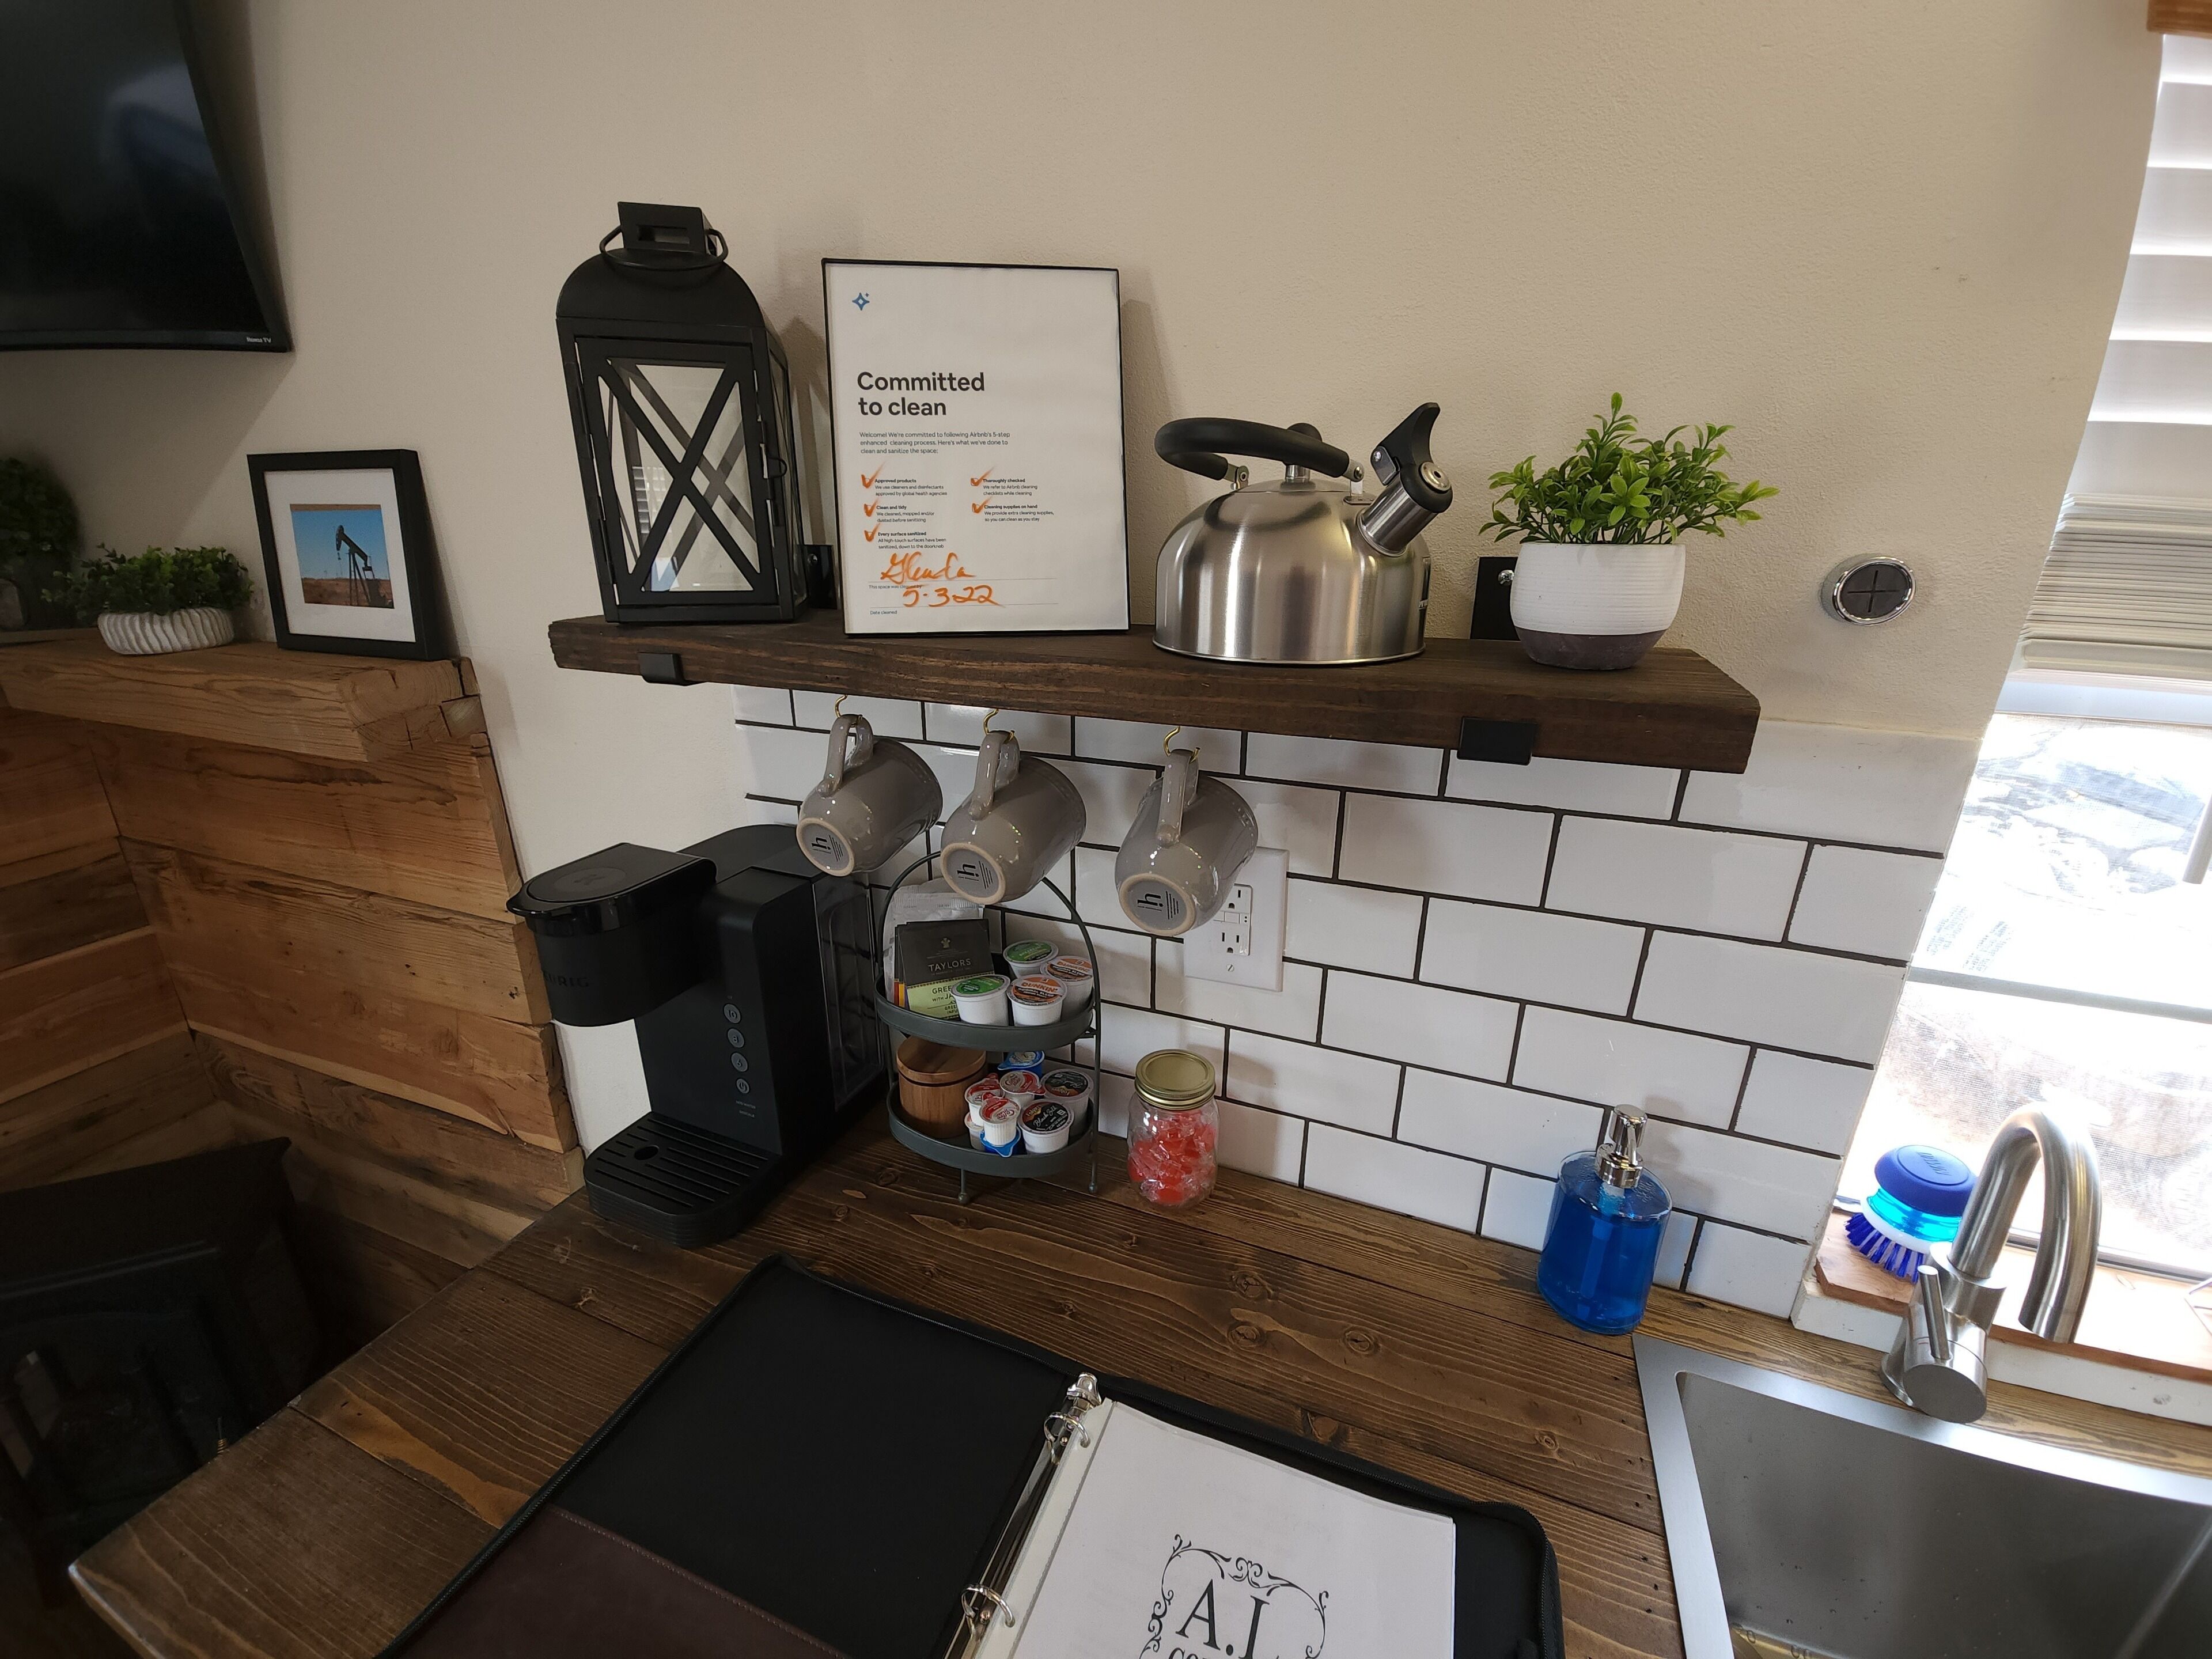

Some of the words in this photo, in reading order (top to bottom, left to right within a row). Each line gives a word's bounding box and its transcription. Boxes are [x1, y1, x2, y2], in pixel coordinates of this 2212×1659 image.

[857, 372, 984, 391] Committed
[858, 397, 882, 415] to
[888, 397, 946, 415] clean
[928, 958, 971, 972] TAYLORS
[932, 986, 952, 994] GREE
